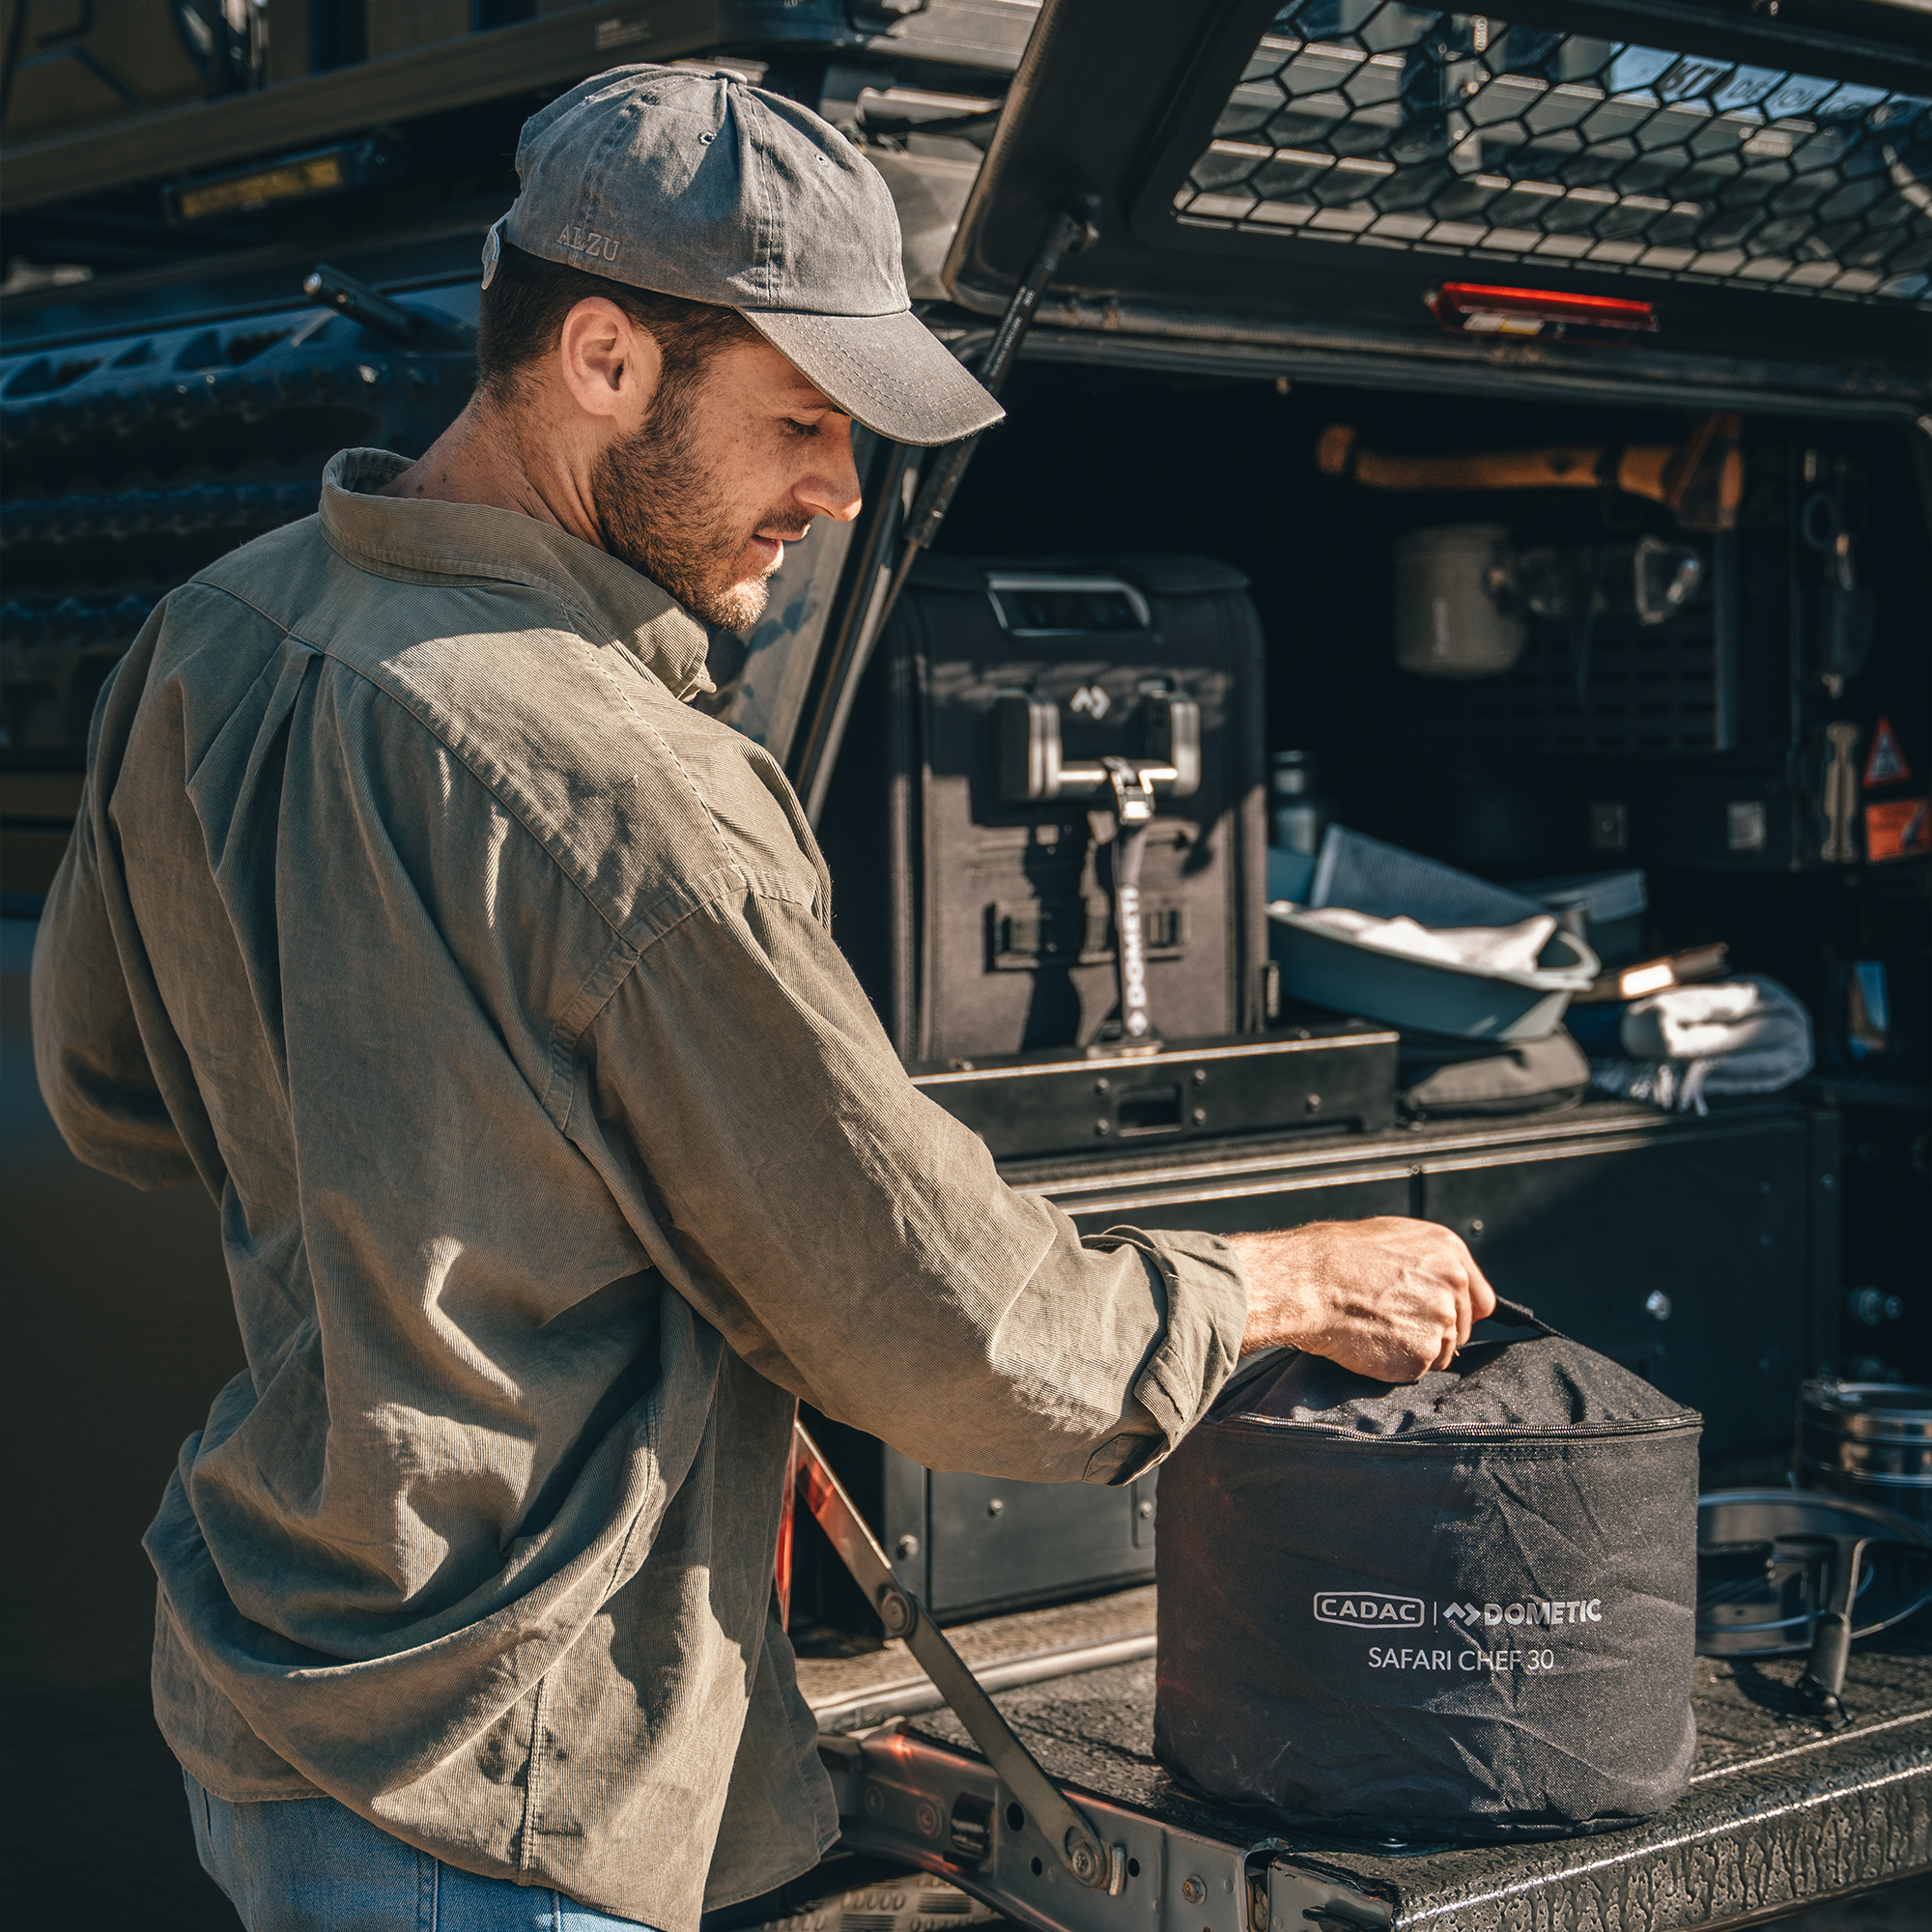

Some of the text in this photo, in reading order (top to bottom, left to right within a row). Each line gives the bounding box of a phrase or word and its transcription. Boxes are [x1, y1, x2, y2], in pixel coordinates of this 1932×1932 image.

[555, 223, 619, 261] ALZU
[1321, 1599, 1603, 1626] CADAC DOMETIC
[1368, 1647, 1554, 1671] SAFARI CHEF 30
